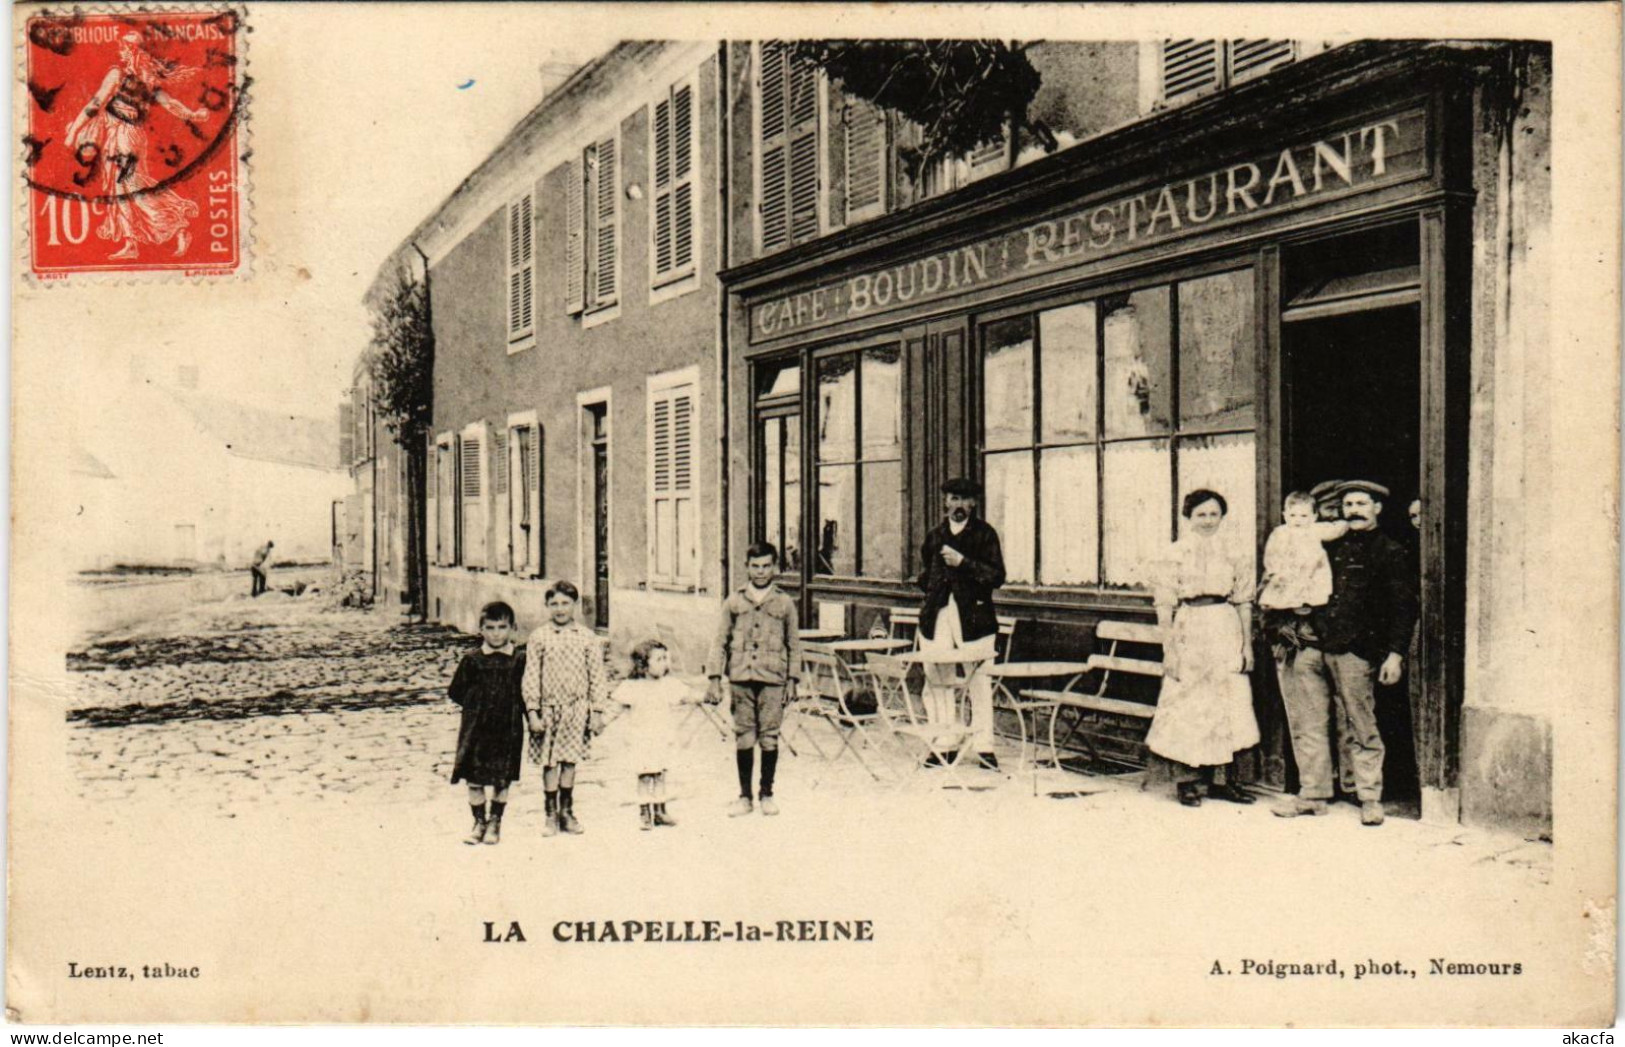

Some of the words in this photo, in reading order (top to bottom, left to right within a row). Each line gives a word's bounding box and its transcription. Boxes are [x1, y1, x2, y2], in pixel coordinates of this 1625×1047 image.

[208, 169, 229, 253] POSTES
[847, 243, 988, 316] BOUDIN
[1023, 118, 1401, 271] RESTAURANT
[482, 921, 527, 942] LA
[552, 920, 874, 943] CHAPELLE-la-REINE
[142, 962, 200, 979] tabac
[1210, 960, 1232, 975] A.
[1241, 959, 1345, 979] Poignard,
[1354, 958, 1417, 980] phot.,
[1429, 958, 1523, 975] Nemours
